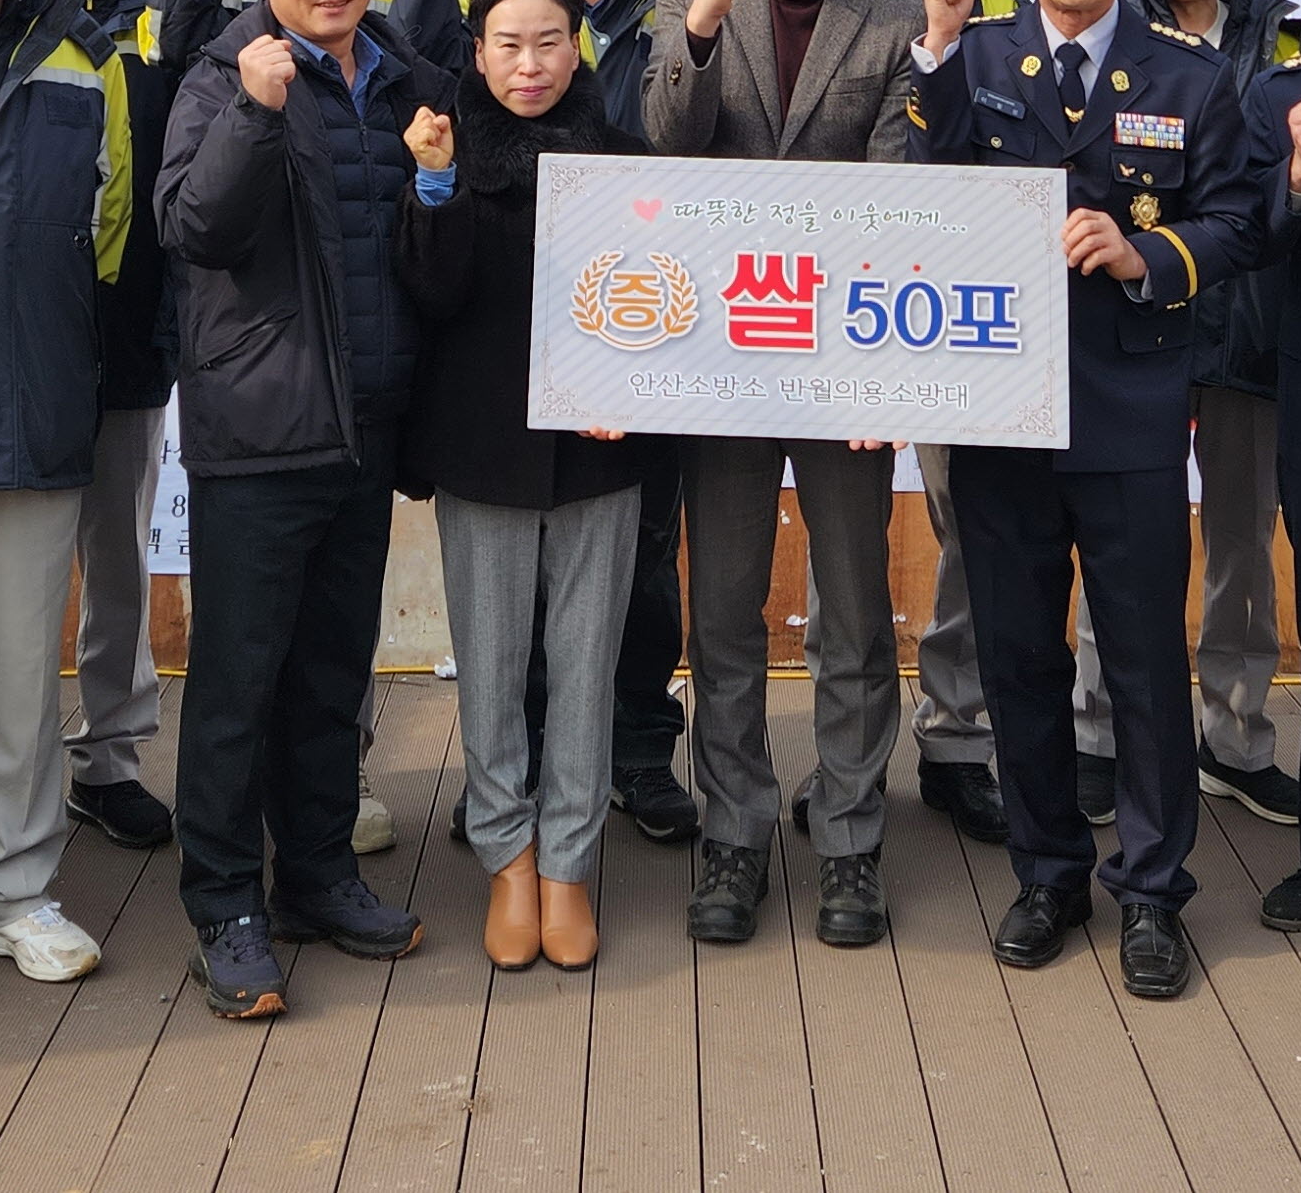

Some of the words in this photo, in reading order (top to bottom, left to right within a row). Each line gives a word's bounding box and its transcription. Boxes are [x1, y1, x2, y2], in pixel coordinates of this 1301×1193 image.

[674, 199, 758, 227] 따뜻한
[770, 201, 822, 233] 정을
[606, 271, 663, 331] 증
[722, 252, 825, 352] 쌀
[844, 280, 1021, 352] 50포
[629, 372, 767, 400] 안산소방소
[779, 377, 970, 410] 반월의용소방대
